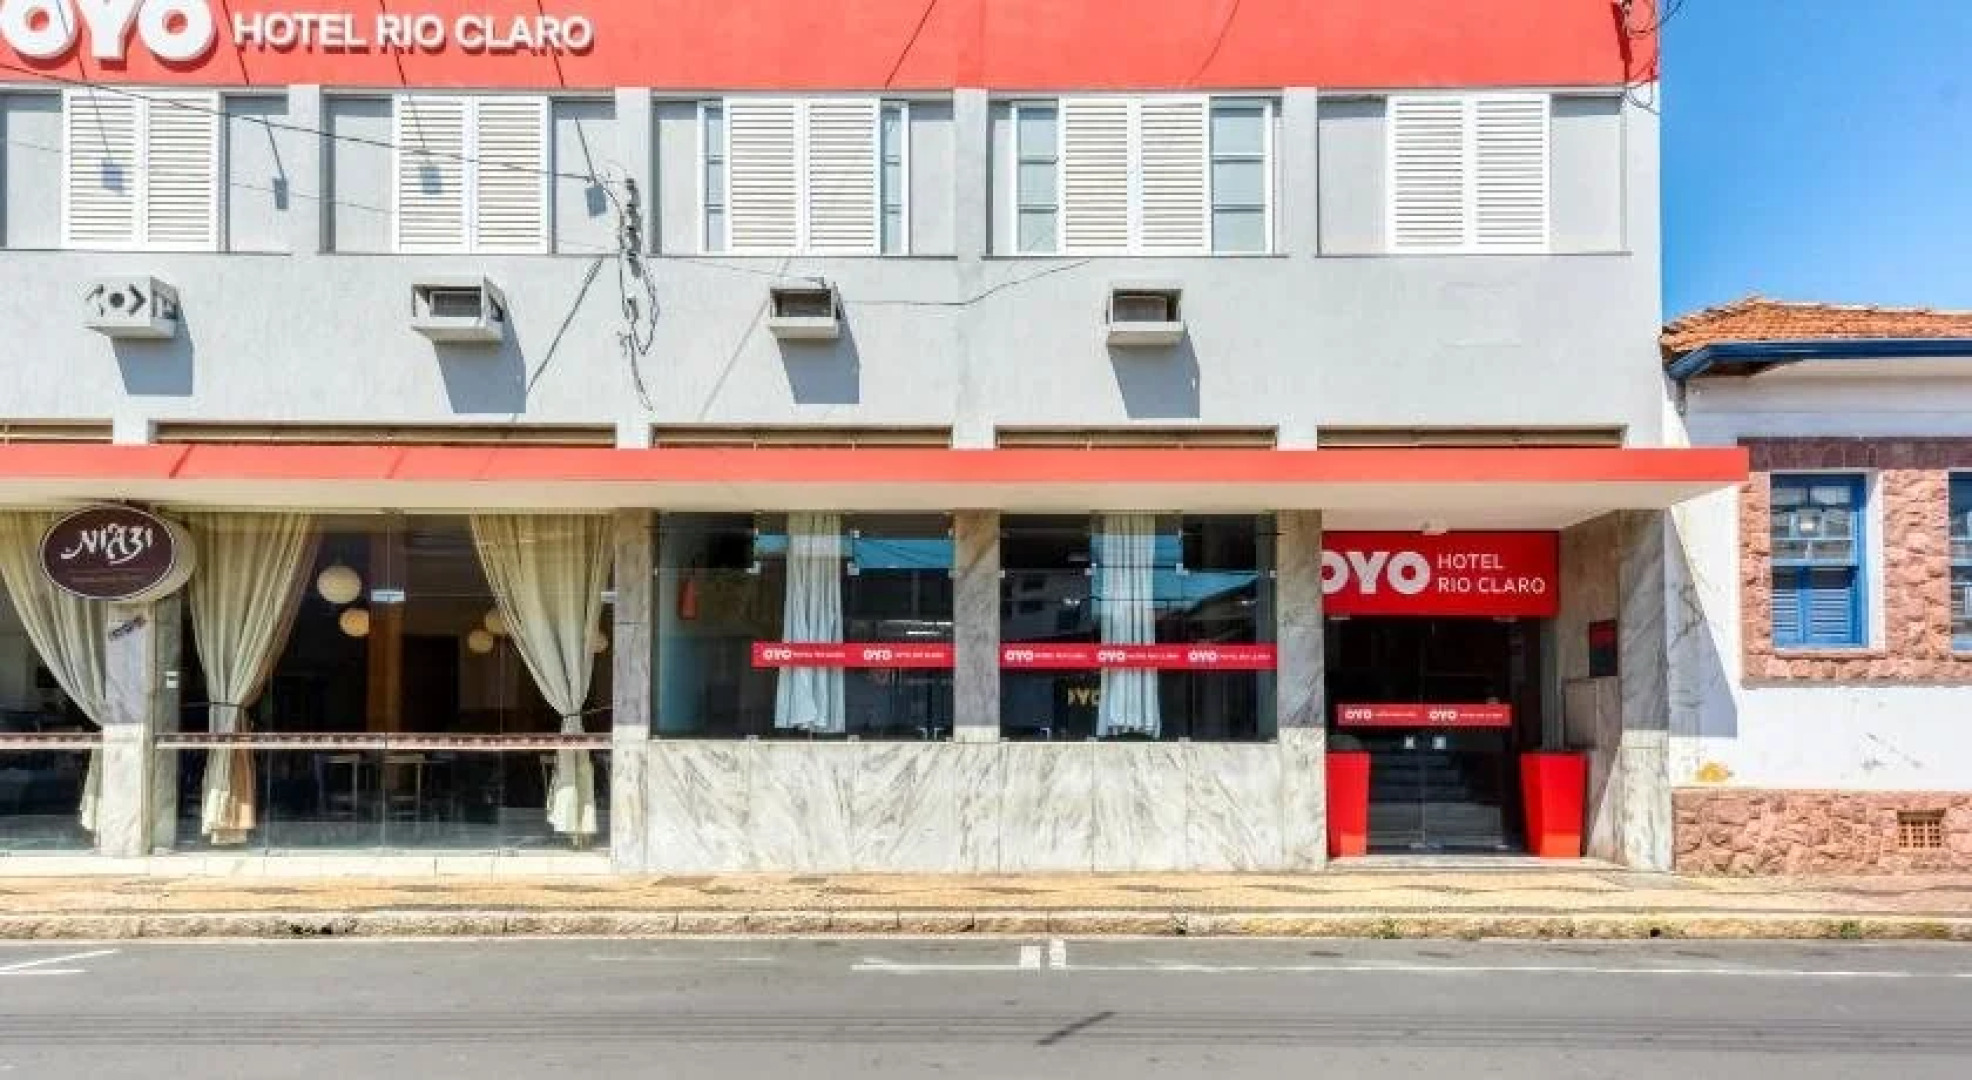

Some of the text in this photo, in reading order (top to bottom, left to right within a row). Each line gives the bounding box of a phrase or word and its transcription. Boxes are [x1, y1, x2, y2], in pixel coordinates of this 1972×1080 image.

[0, 0, 593, 60] OYO HOTEL RIO CLARO
[1438, 554, 1502, 569] HOTEL
[1438, 577, 1546, 594] RIO CLARO
